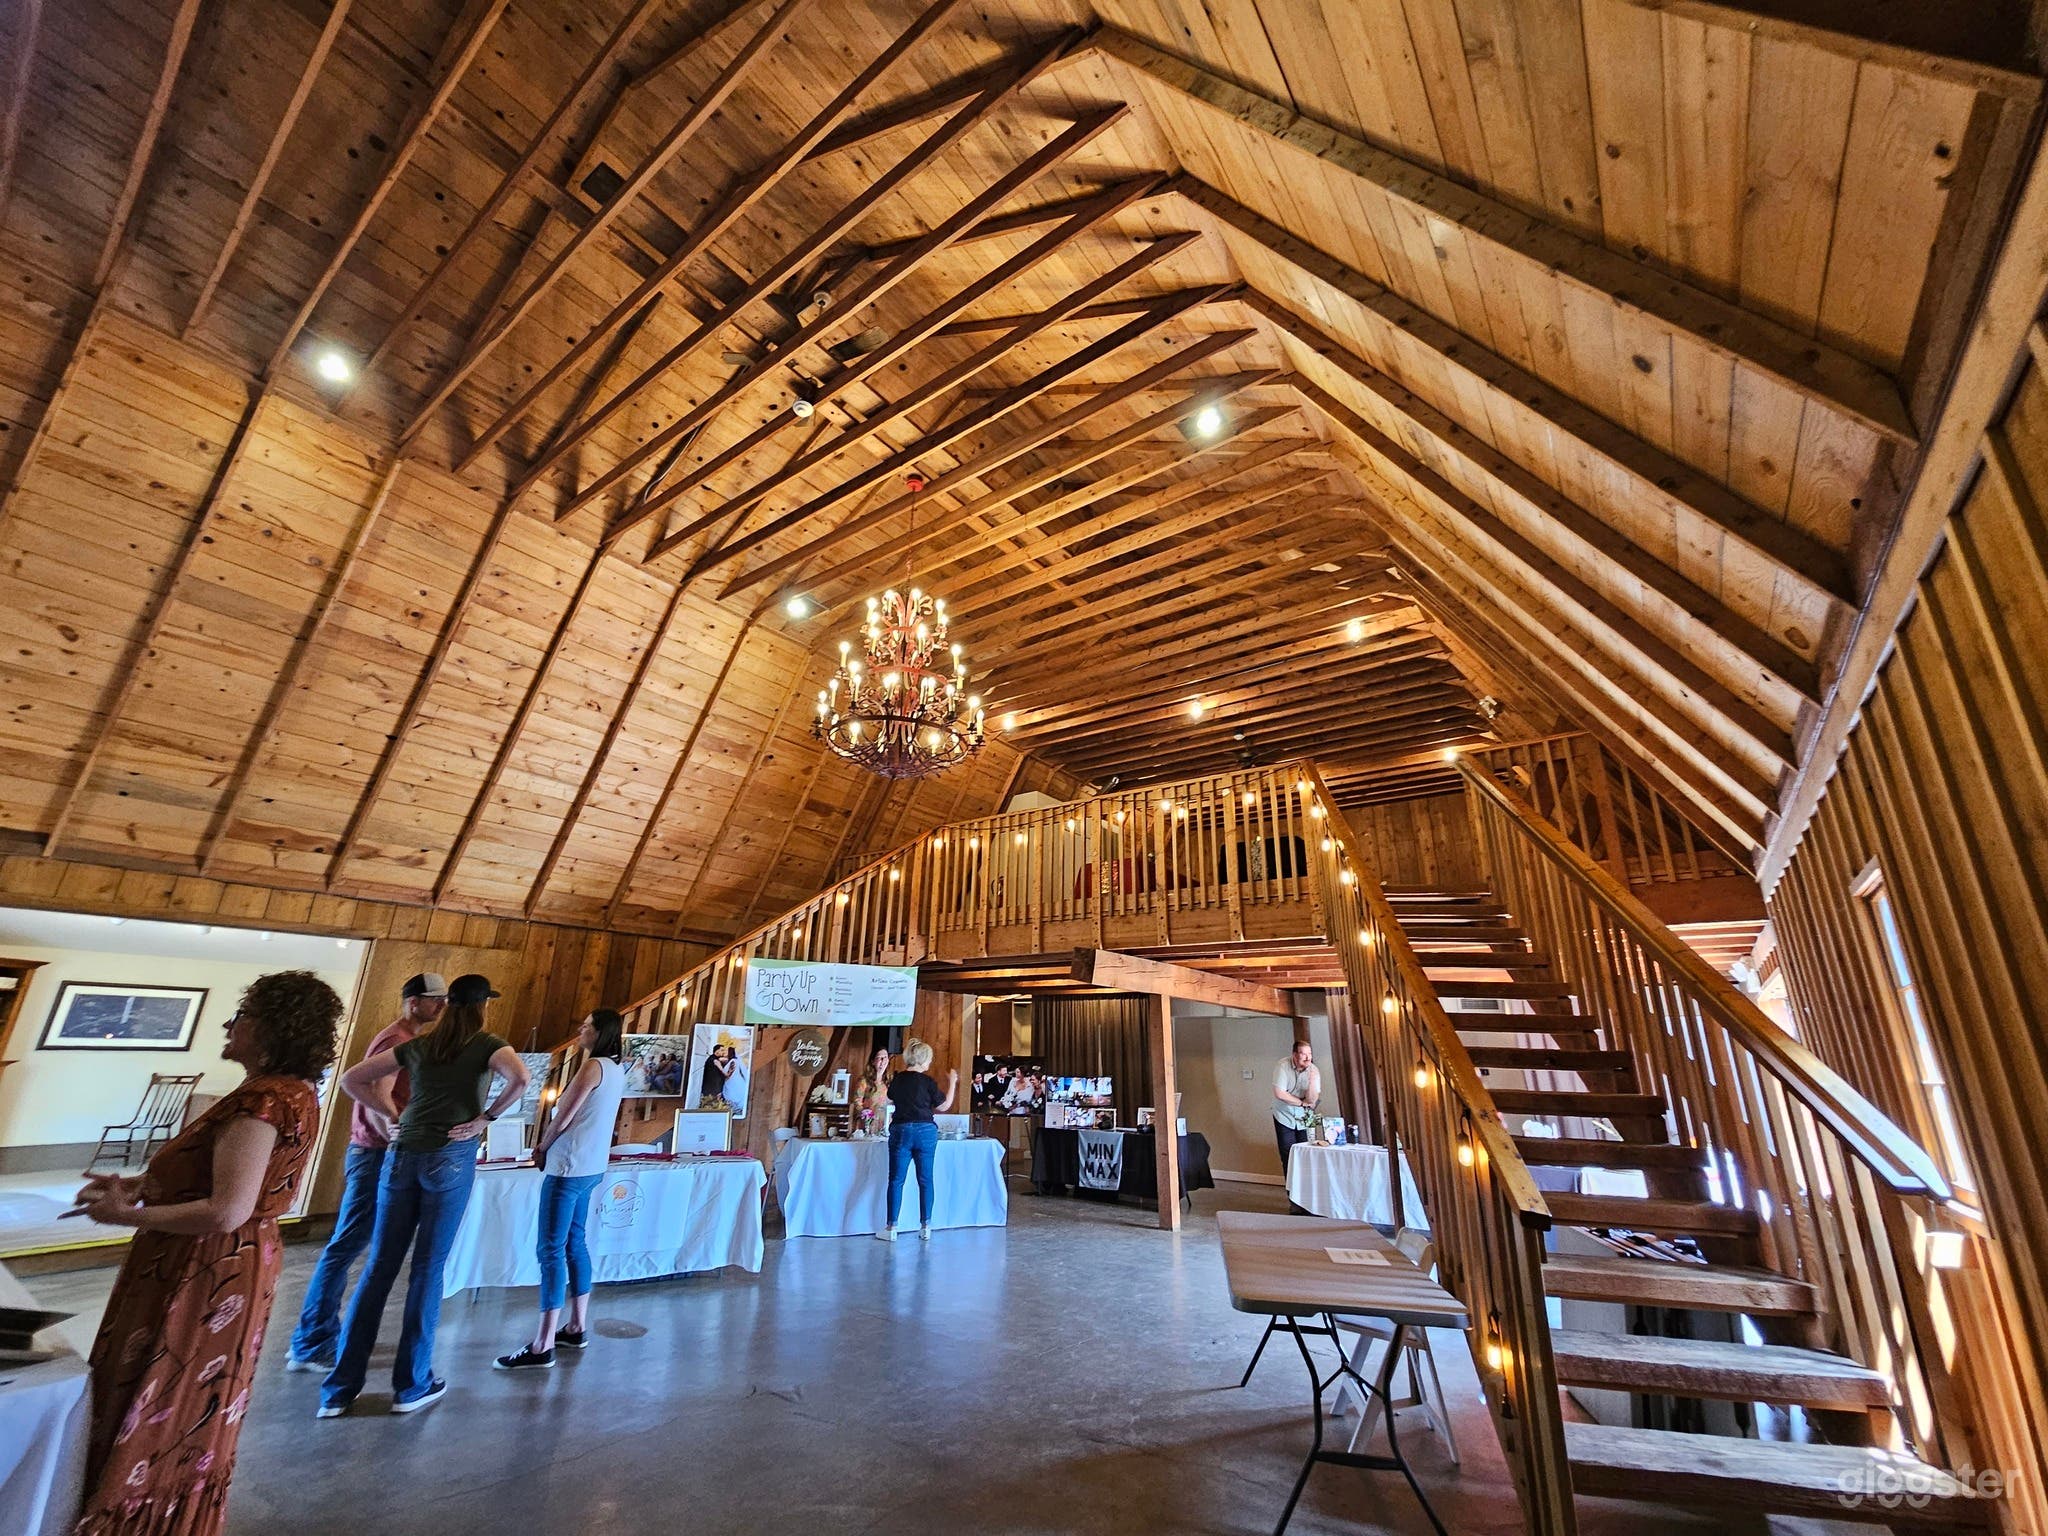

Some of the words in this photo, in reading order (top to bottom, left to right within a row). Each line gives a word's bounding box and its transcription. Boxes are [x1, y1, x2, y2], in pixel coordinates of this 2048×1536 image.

[757, 968, 799, 995] Party
[800, 970, 817, 994] Up
[771, 992, 819, 1013] Down
[1087, 1142, 1114, 1160] MIN
[1084, 1160, 1119, 1180] MAX
